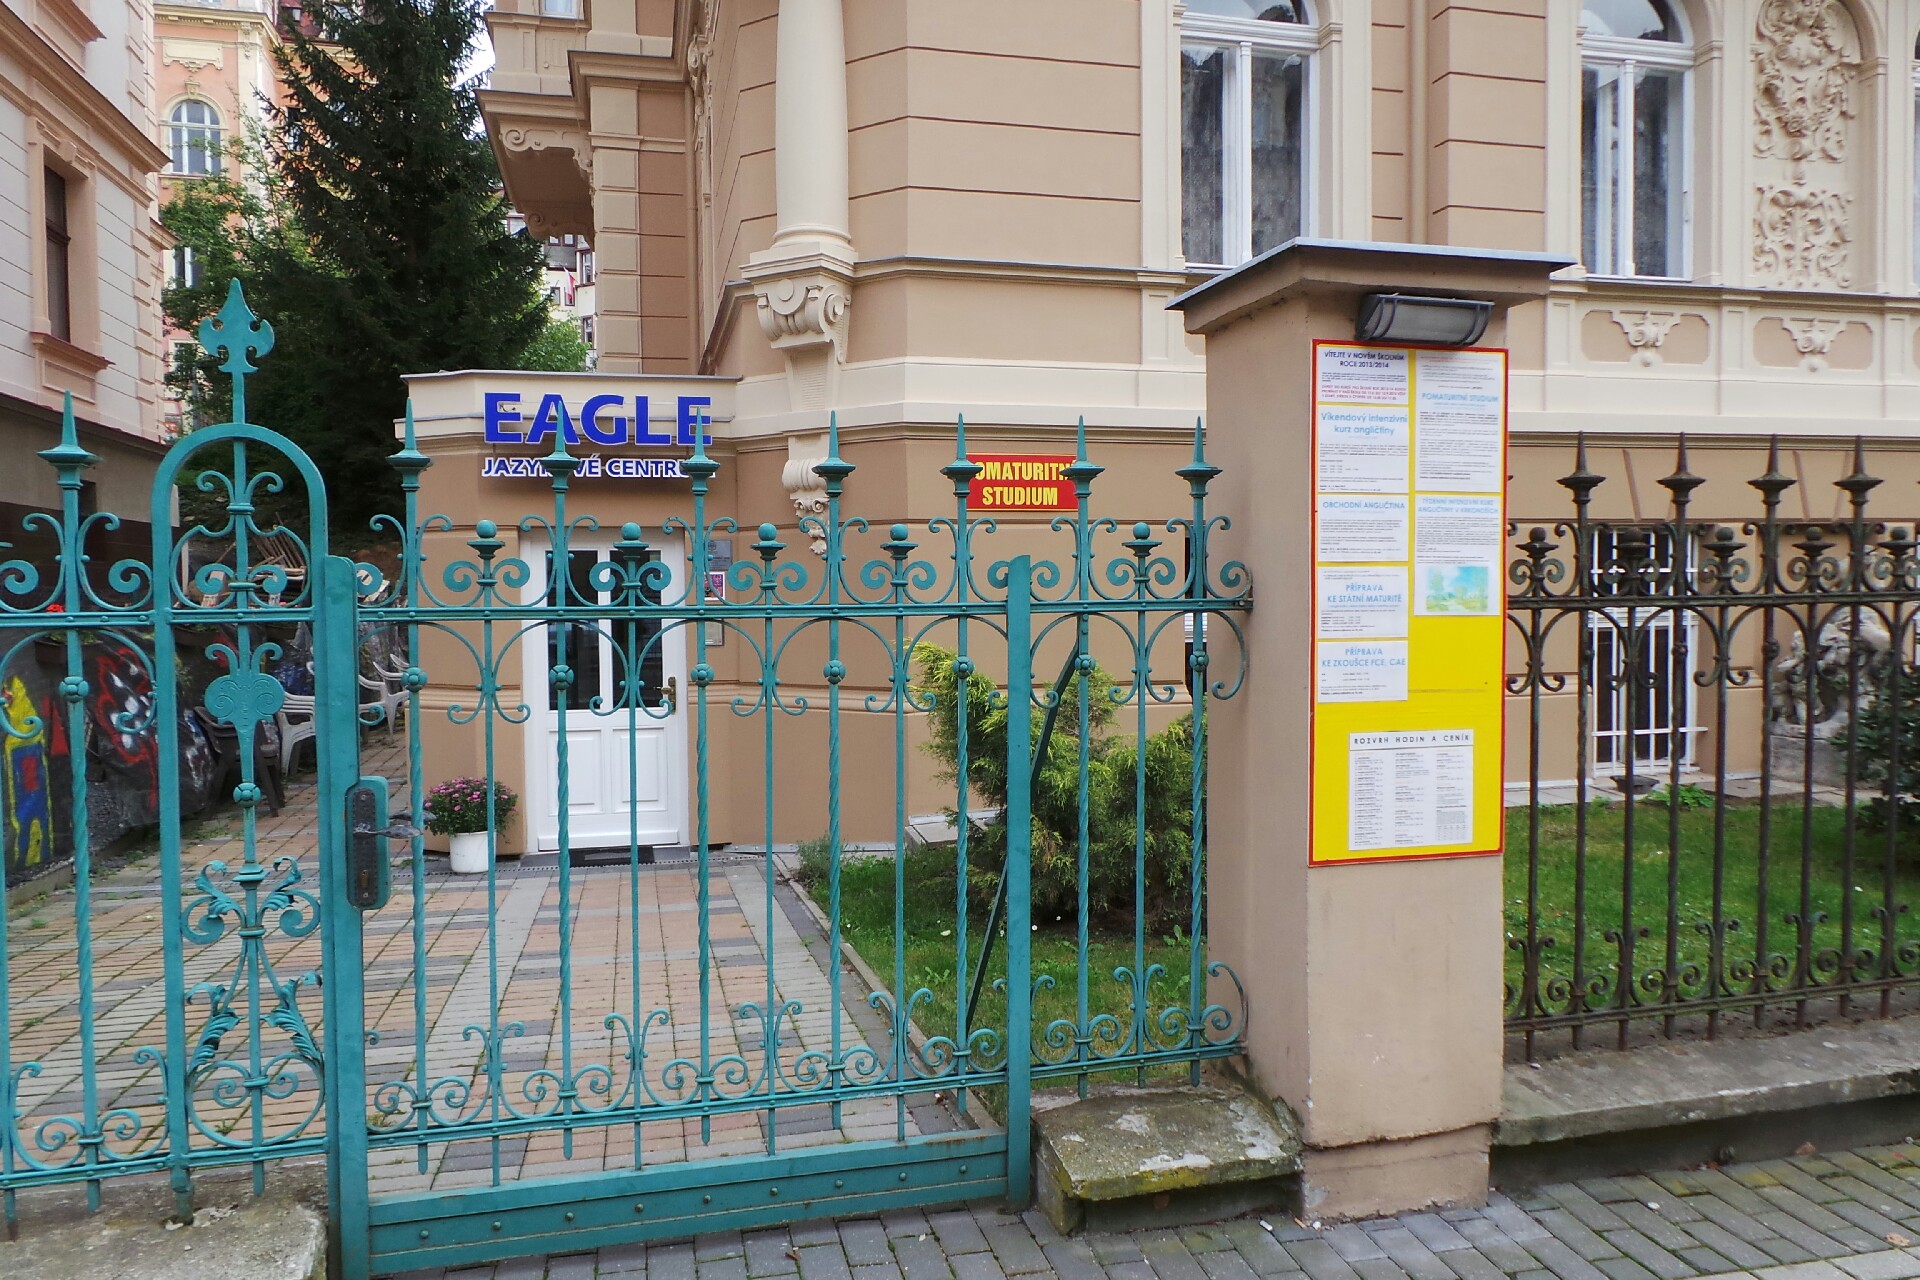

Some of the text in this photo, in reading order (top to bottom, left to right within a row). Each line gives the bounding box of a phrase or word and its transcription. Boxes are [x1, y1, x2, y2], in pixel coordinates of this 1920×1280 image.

[484, 392, 713, 446] EAGLE
[1321, 412, 1367, 423] Víkendový
[1334, 425, 1395, 436] kurz angličtiny
[481, 453, 716, 478] JAZYVÉ CENTR
[982, 486, 1058, 506] STUDIUM
[1322, 501, 1361, 509] OBCHODNÍ
[1345, 582, 1384, 592] PŘÍPRAVA
[1327, 595, 1337, 603] KE
[1338, 593, 1364, 603] STÁTNÍ
[1345, 646, 1384, 656] PŘÍPRAVA
[1322, 659, 1331, 667] KE
[1333, 658, 1369, 667] ZKOUŠCE
[1389, 658, 1406, 666] CAE
[1443, 733, 1470, 742] CENÍK
